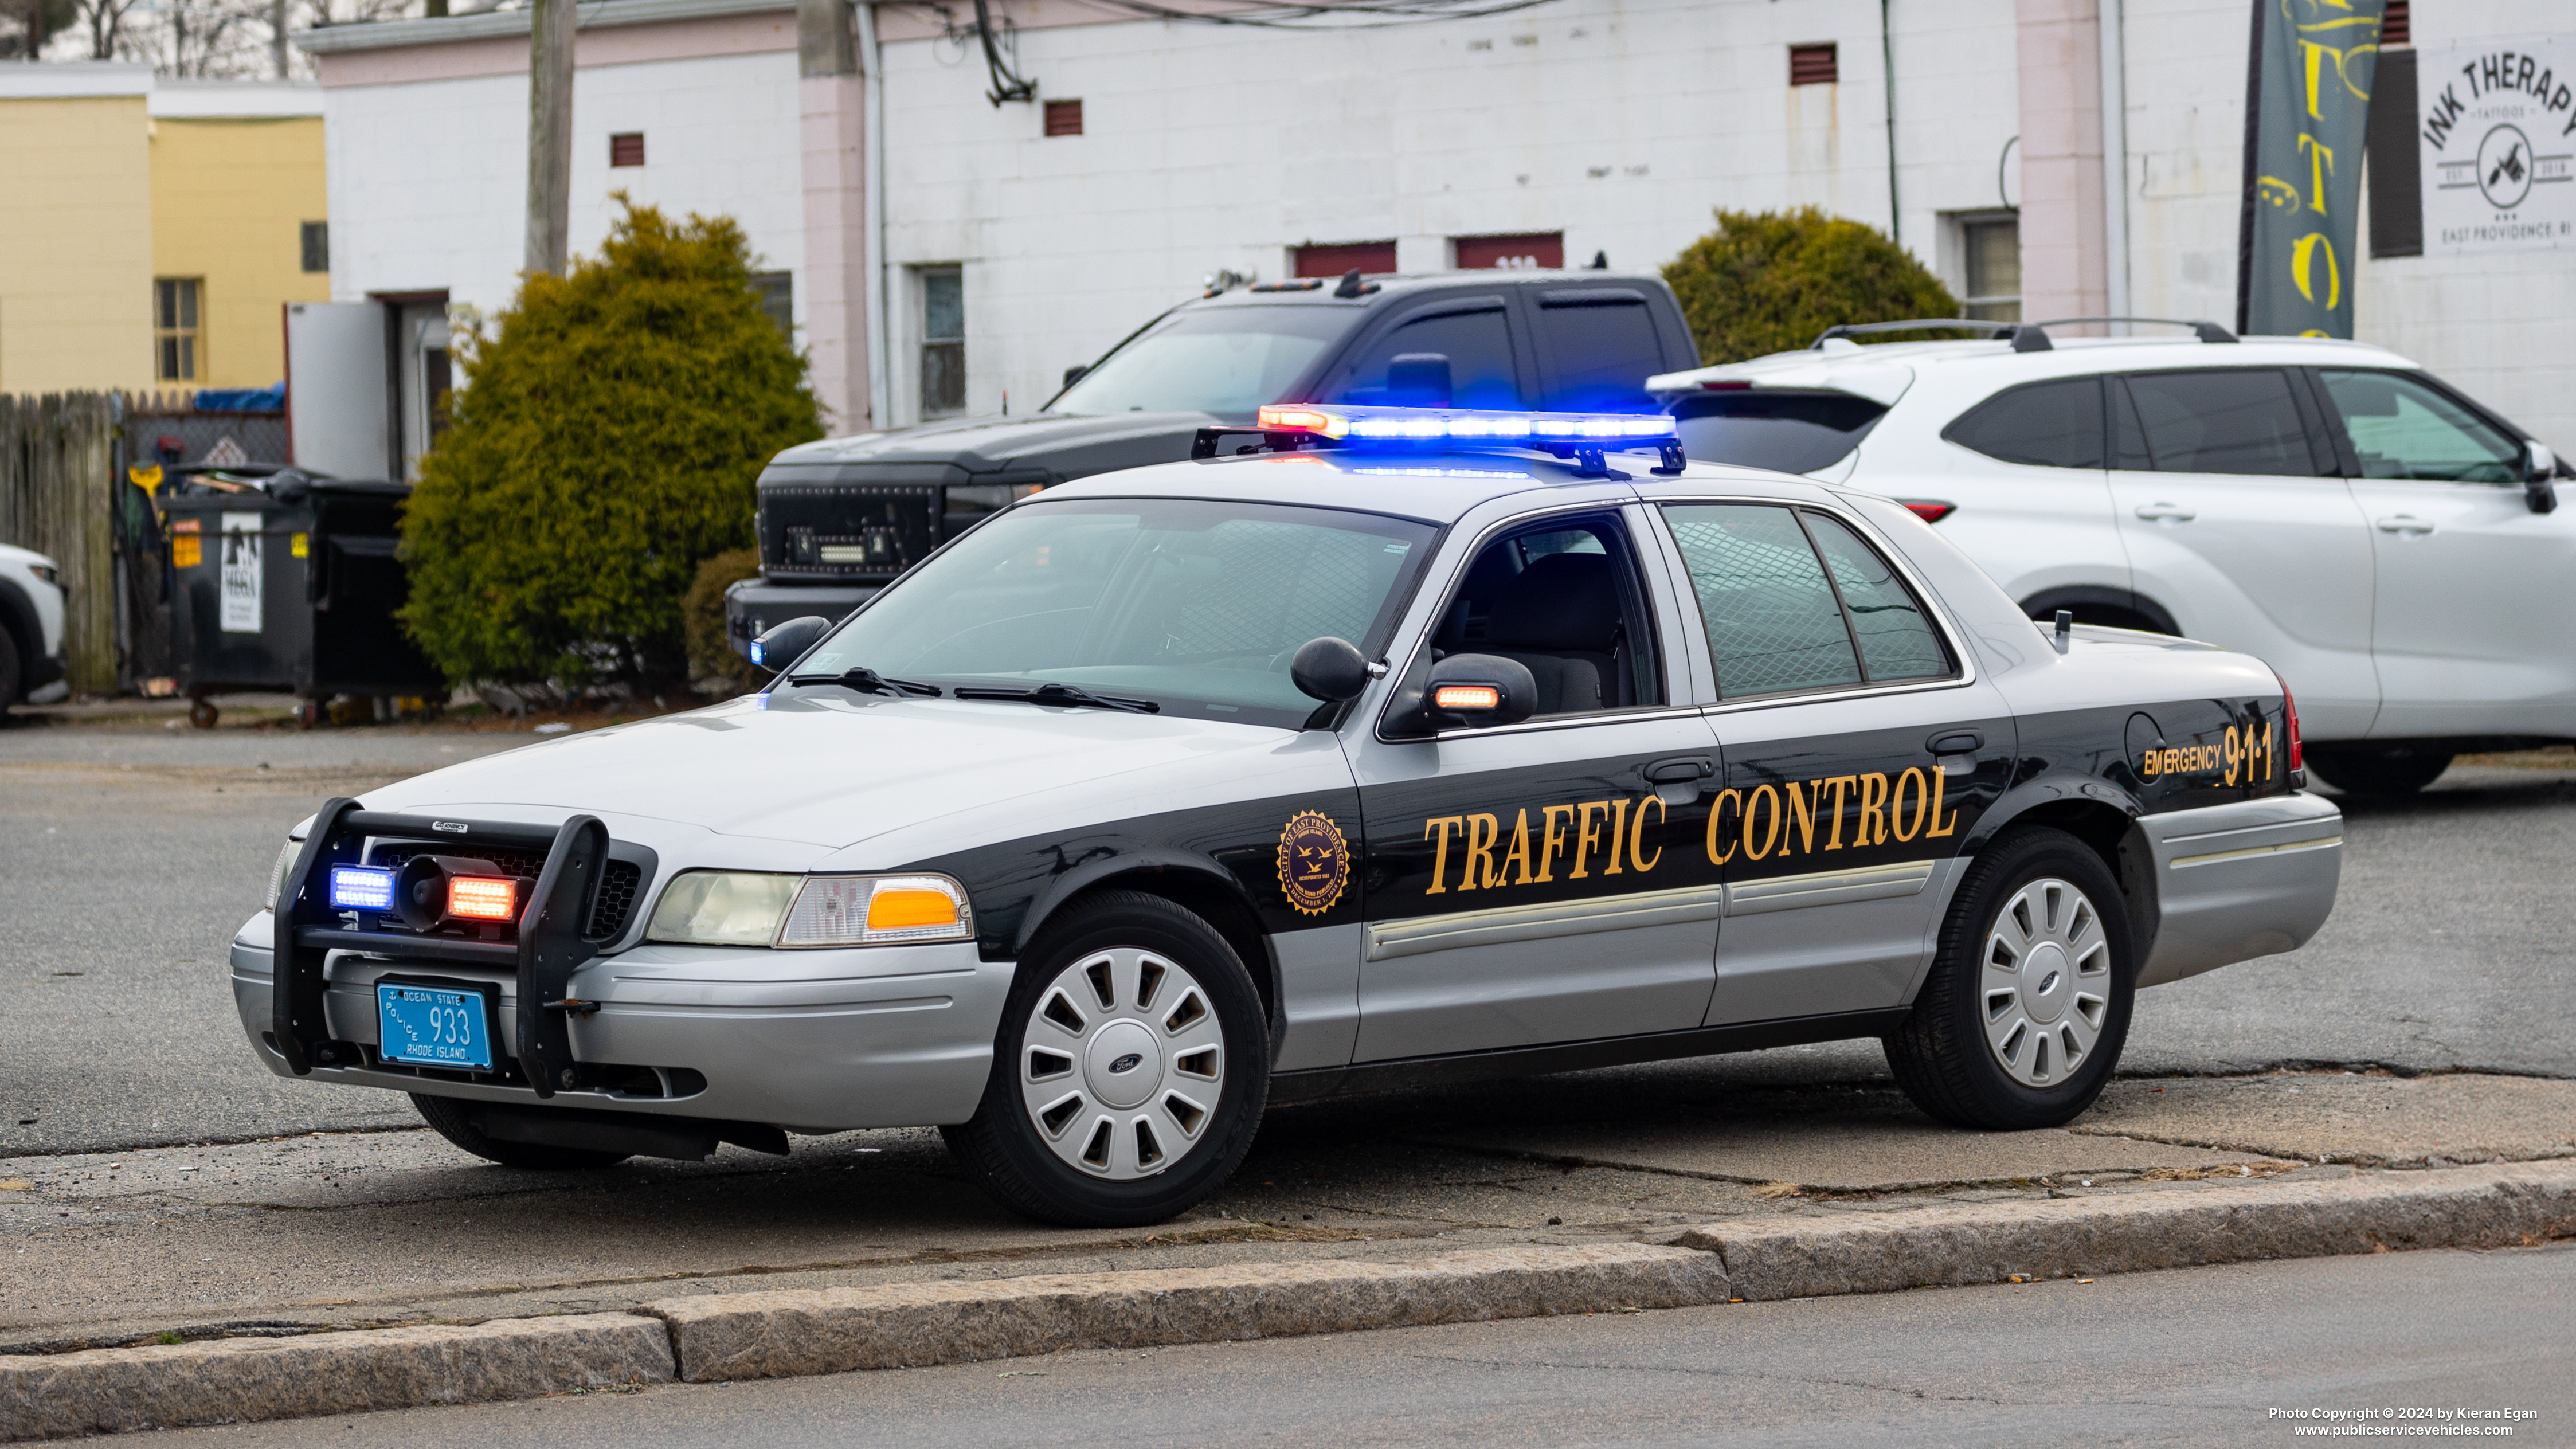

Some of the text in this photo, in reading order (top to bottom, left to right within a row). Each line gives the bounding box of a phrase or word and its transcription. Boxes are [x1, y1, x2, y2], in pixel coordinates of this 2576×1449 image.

[2422, 81, 2465, 151] INK
[2442, 226, 2469, 244] EAST
[2560, 220, 2571, 236] RI
[2144, 745, 2222, 775] EMERGENCY
[1285, 831, 1294, 845] OF
[1292, 818, 1309, 835] EAST
[1310, 818, 1345, 867] PROVIDENCE
[1424, 765, 1958, 895] TRAFFIC CONTROL
[1291, 888, 1321, 906] DECEMBER
[403, 992, 461, 1007] OCEAN STATE
[386, 1002, 418, 1041] POLICE
[430, 1006, 471, 1045] 933
[406, 1044, 465, 1060] RHODE ISLAND
[1116, 1059, 1134, 1071] Ford
